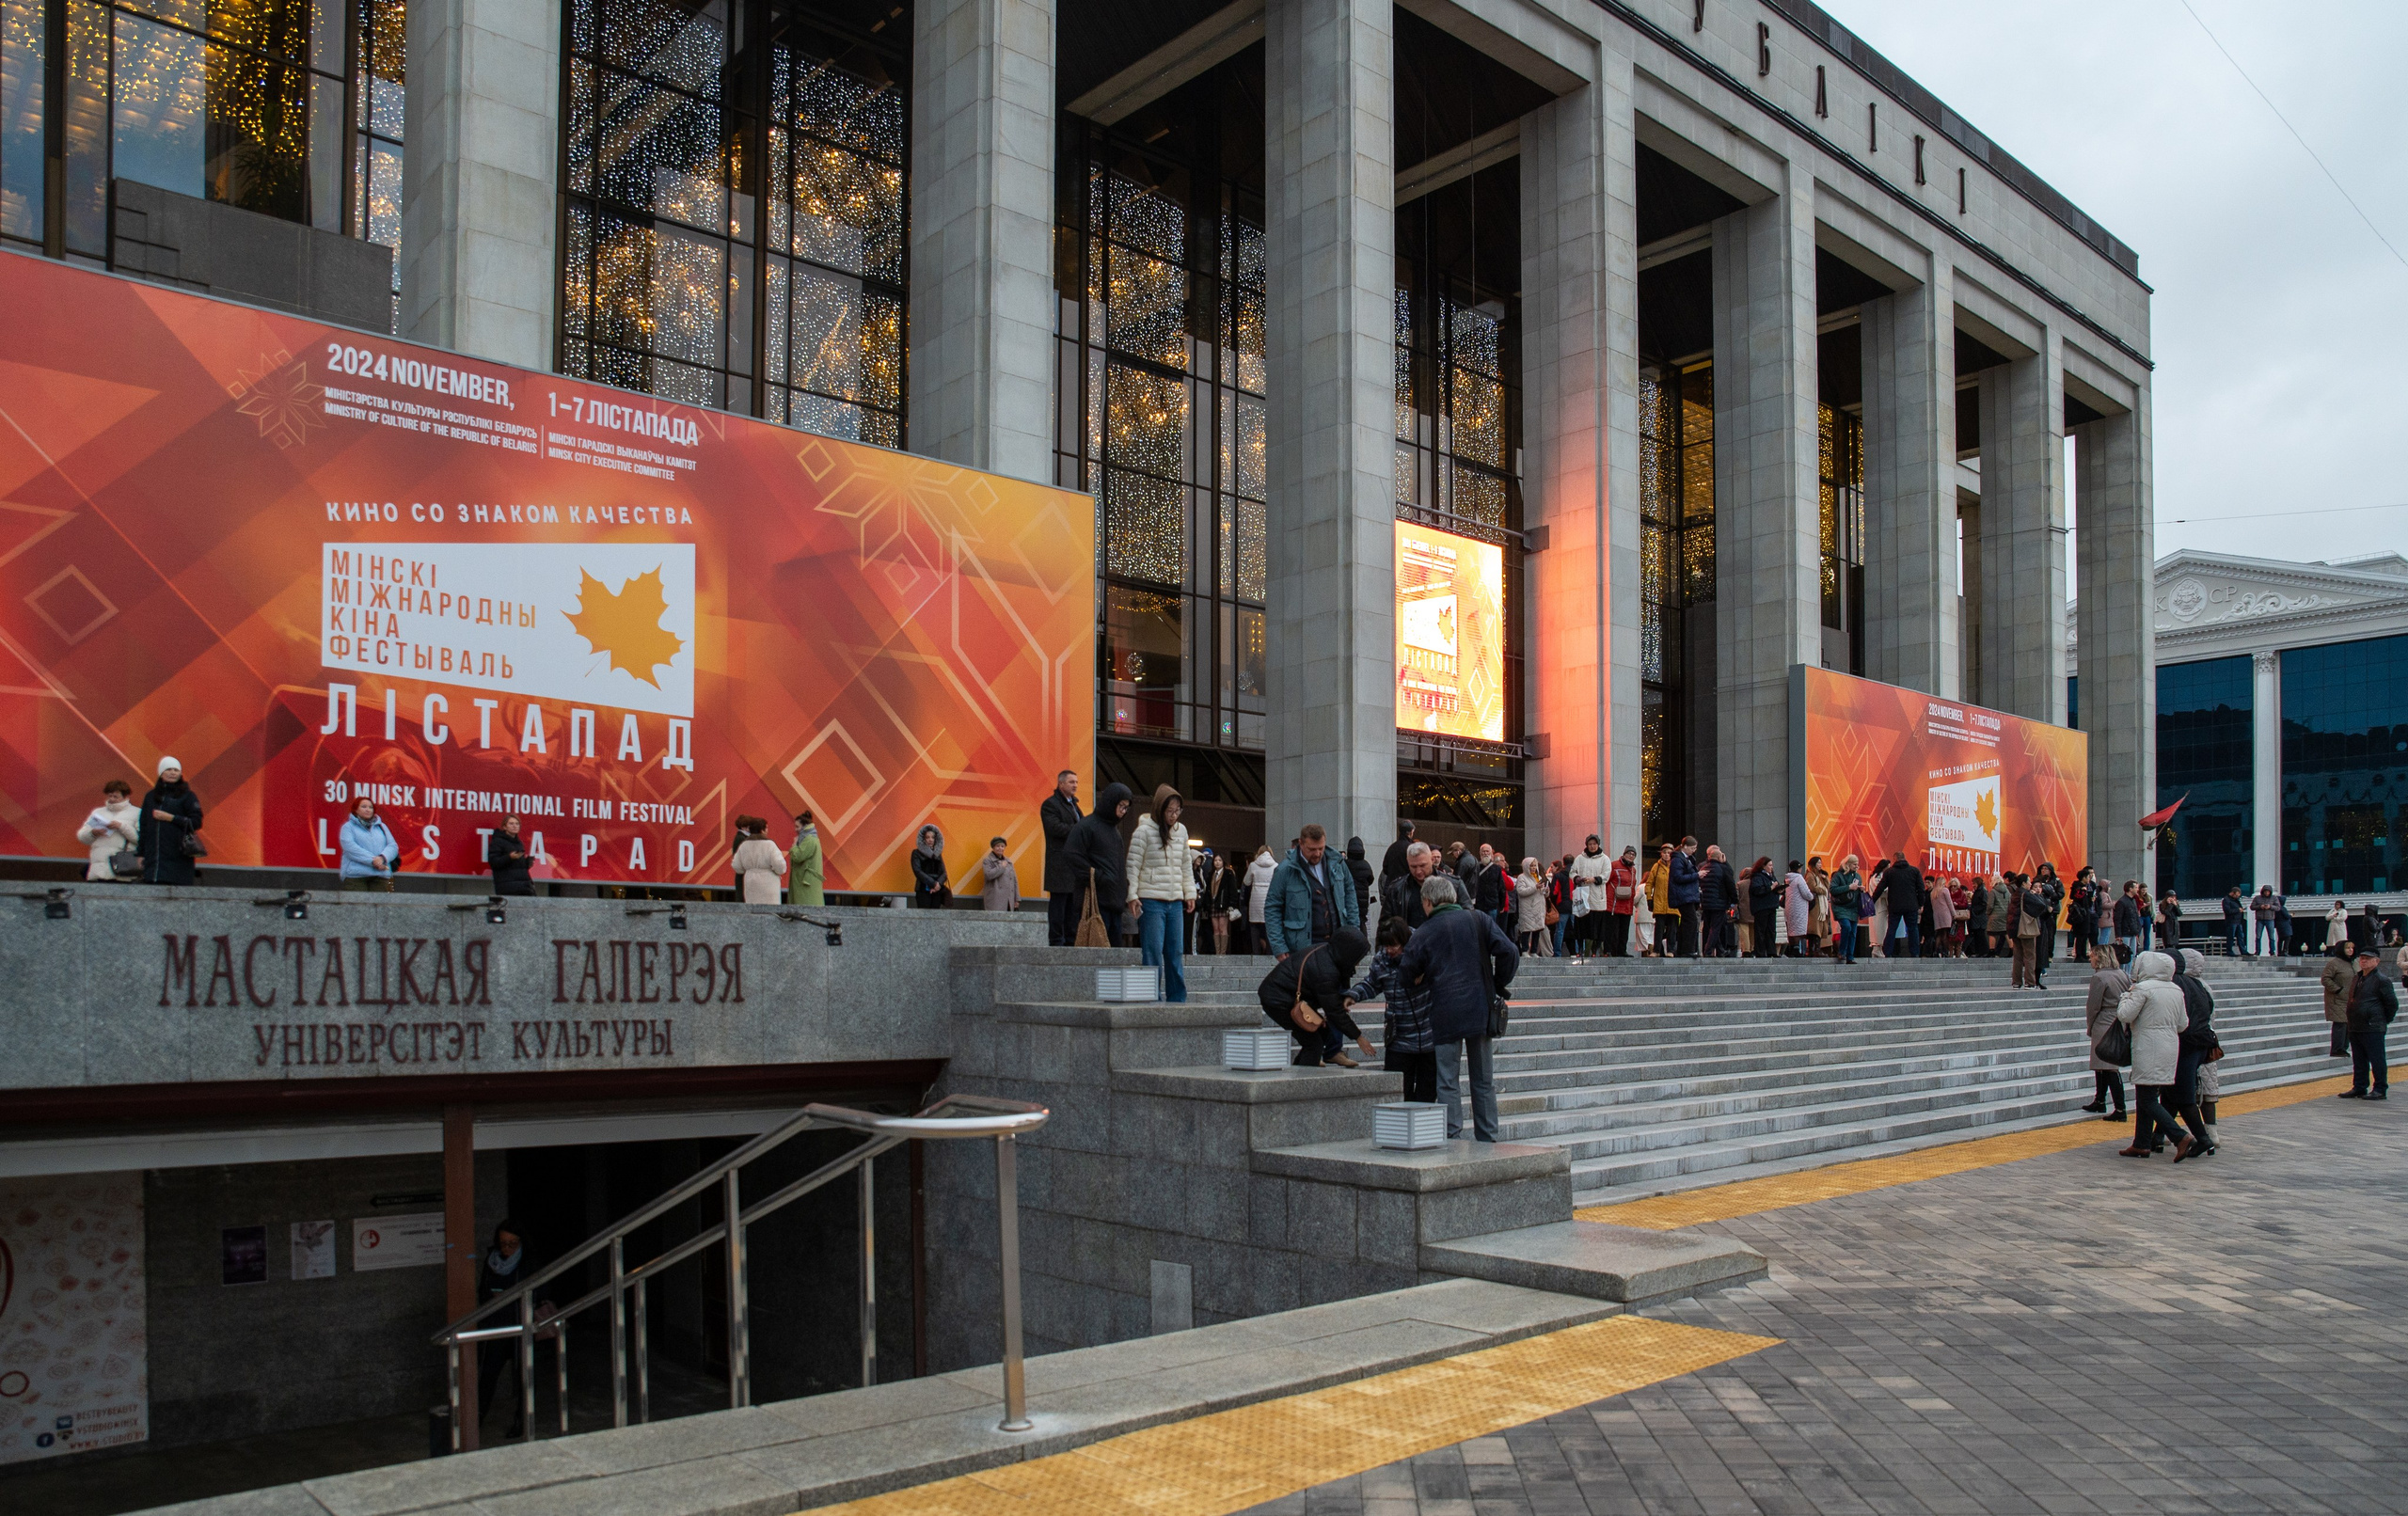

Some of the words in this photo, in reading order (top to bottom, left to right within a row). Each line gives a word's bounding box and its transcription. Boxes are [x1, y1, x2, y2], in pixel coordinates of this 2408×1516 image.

[327, 343, 388, 382] 2024
[391, 356, 515, 411] NOVEMBER,
[325, 387, 389, 410] МІНІСТЭРСТВА
[391, 400, 441, 419] КУЛЬТУРЫ
[442, 410, 493, 430] РЭСПУБЛІКІ
[495, 420, 538, 439] БЕЛАРУСЬ
[325, 402, 367, 420] MINISTRY
[369, 411, 380, 423] OF
[381, 413, 420, 431] CULTURE
[420, 421, 432, 433] OF
[433, 423, 450, 436] THE
[451, 427, 489, 445] REPUBLIC
[490, 434, 501, 446] OF
[502, 437, 537, 453] BELARUS
[586, 399, 699, 447] ЛІСТАПАДА
[548, 432, 577, 447] МІНСКІ
[578, 438, 615, 454] ГАРАДСКІ
[616, 445, 664, 465] ВЫКАНАЎЧЫ
[666, 456, 697, 471] КАМІТЭТ
[548, 447, 574, 462] MINSK
[575, 452, 592, 465] CITY
[593, 456, 632, 473] EXECUTIVE
[633, 464, 675, 482] COMMITTEE
[326, 502, 399, 523] КИНО
[412, 503, 445, 523] СО
[458, 504, 560, 524] ЗНАКОМ
[569, 505, 693, 525] КАЧЕСТВА
[331, 549, 436, 589] МІНСКІ
[331, 577, 536, 628] МІЖНАРОДНЫ
[331, 606, 400, 639] КІНА
[329, 634, 514, 680] ФЕСТЫВАЛЬ
[321, 683, 694, 772] ЛІСТАПАД
[1928, 703, 1940, 717] 2024
[1929, 768, 1943, 779] КИНО
[1944, 766, 1952, 777] СО
[1953, 763, 1973, 775] ЗНАКОМ
[1974, 758, 2000, 771] КАЧЕСТВА
[325, 780, 347, 803] 30
[355, 782, 416, 807] MINSK
[425, 787, 564, 817] INTERNATIONAL
[573, 798, 611, 820] FILM
[621, 801, 694, 826] FESTIVAL
[1930, 790, 1950, 805] МІНСКІ
[1930, 802, 1970, 819] МІЖНАРОДНЫ
[1930, 814, 1943, 827] КІНА
[1930, 827, 1965, 842] ФЕСТЫВАЛЬ
[319, 817, 694, 873] LSTAPAD
[1928, 846, 2001, 876] ЛІСТАПАД
[158, 934, 492, 1014] МАСТАЦКАЯ
[550, 939, 745, 1004] ГАЛЕРЭЯ
[253, 1020, 485, 1067] УНІВЕРСІТЭТ
[511, 1019, 673, 1060] КУЛЬТУРЫ
